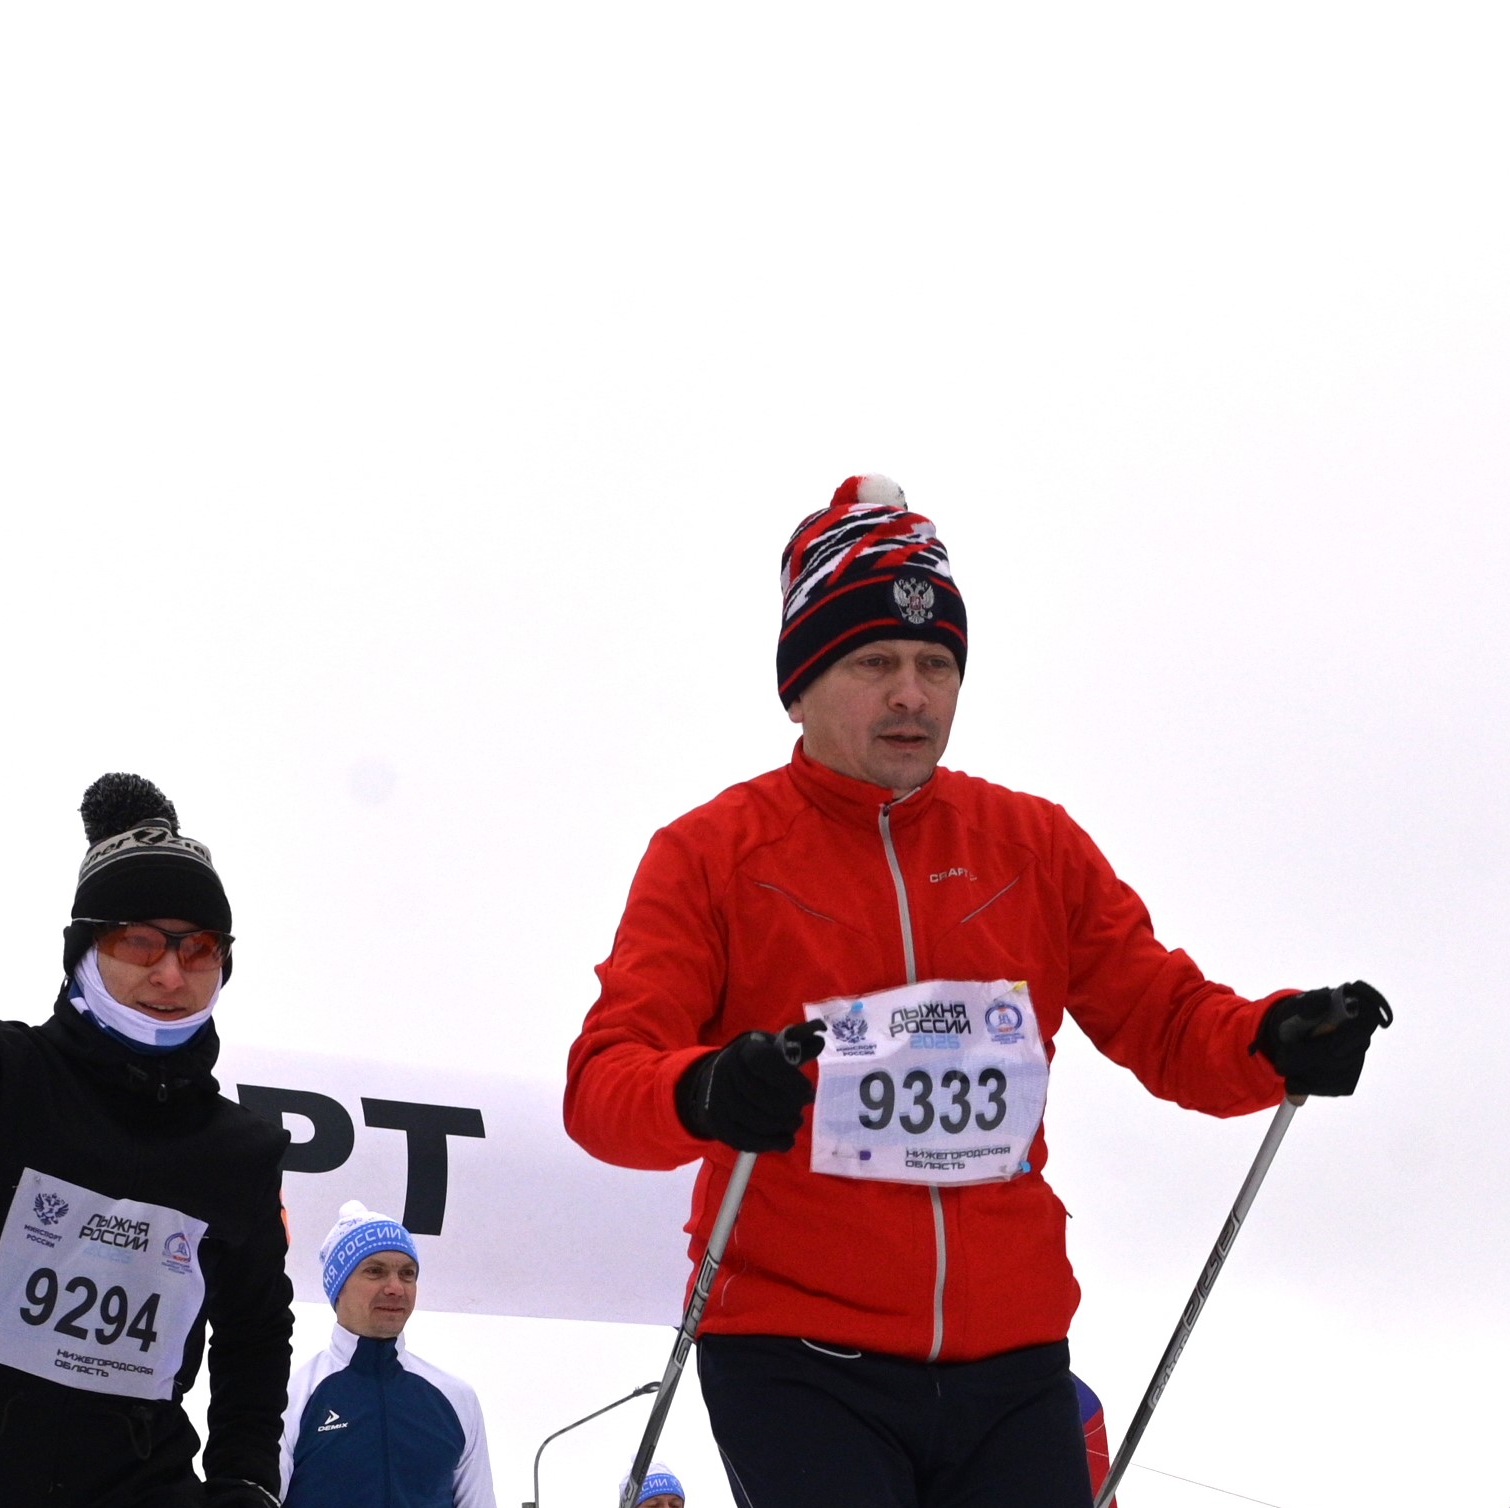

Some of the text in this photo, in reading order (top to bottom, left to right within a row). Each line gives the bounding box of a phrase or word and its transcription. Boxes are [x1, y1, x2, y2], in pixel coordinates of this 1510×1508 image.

[891, 1003, 969, 1026] ЛЫЖНЯ
[889, 1020, 971, 1038] РОССИИ
[858, 1067, 1007, 1135] 9333
[906, 1145, 1011, 1161] НИЖЕГОРОДСКАЯ
[905, 1160, 966, 1171] ОБЛАСТЬ
[23, 1224, 63, 1242] МИНСПОРТ
[86, 1213, 151, 1237] ЛЫЖНЯ
[26, 1234, 56, 1249] РОССИИ
[78, 1228, 149, 1253] РОССИИ
[338, 1227, 403, 1266] РОССИИ
[19, 1267, 162, 1353] 9294
[54, 1358, 109, 1378] ОБЛАСТЬ
[56, 1348, 154, 1377] НИЖЕГОРОДСКАЯ
[317, 1421, 348, 1432] DEMIX
